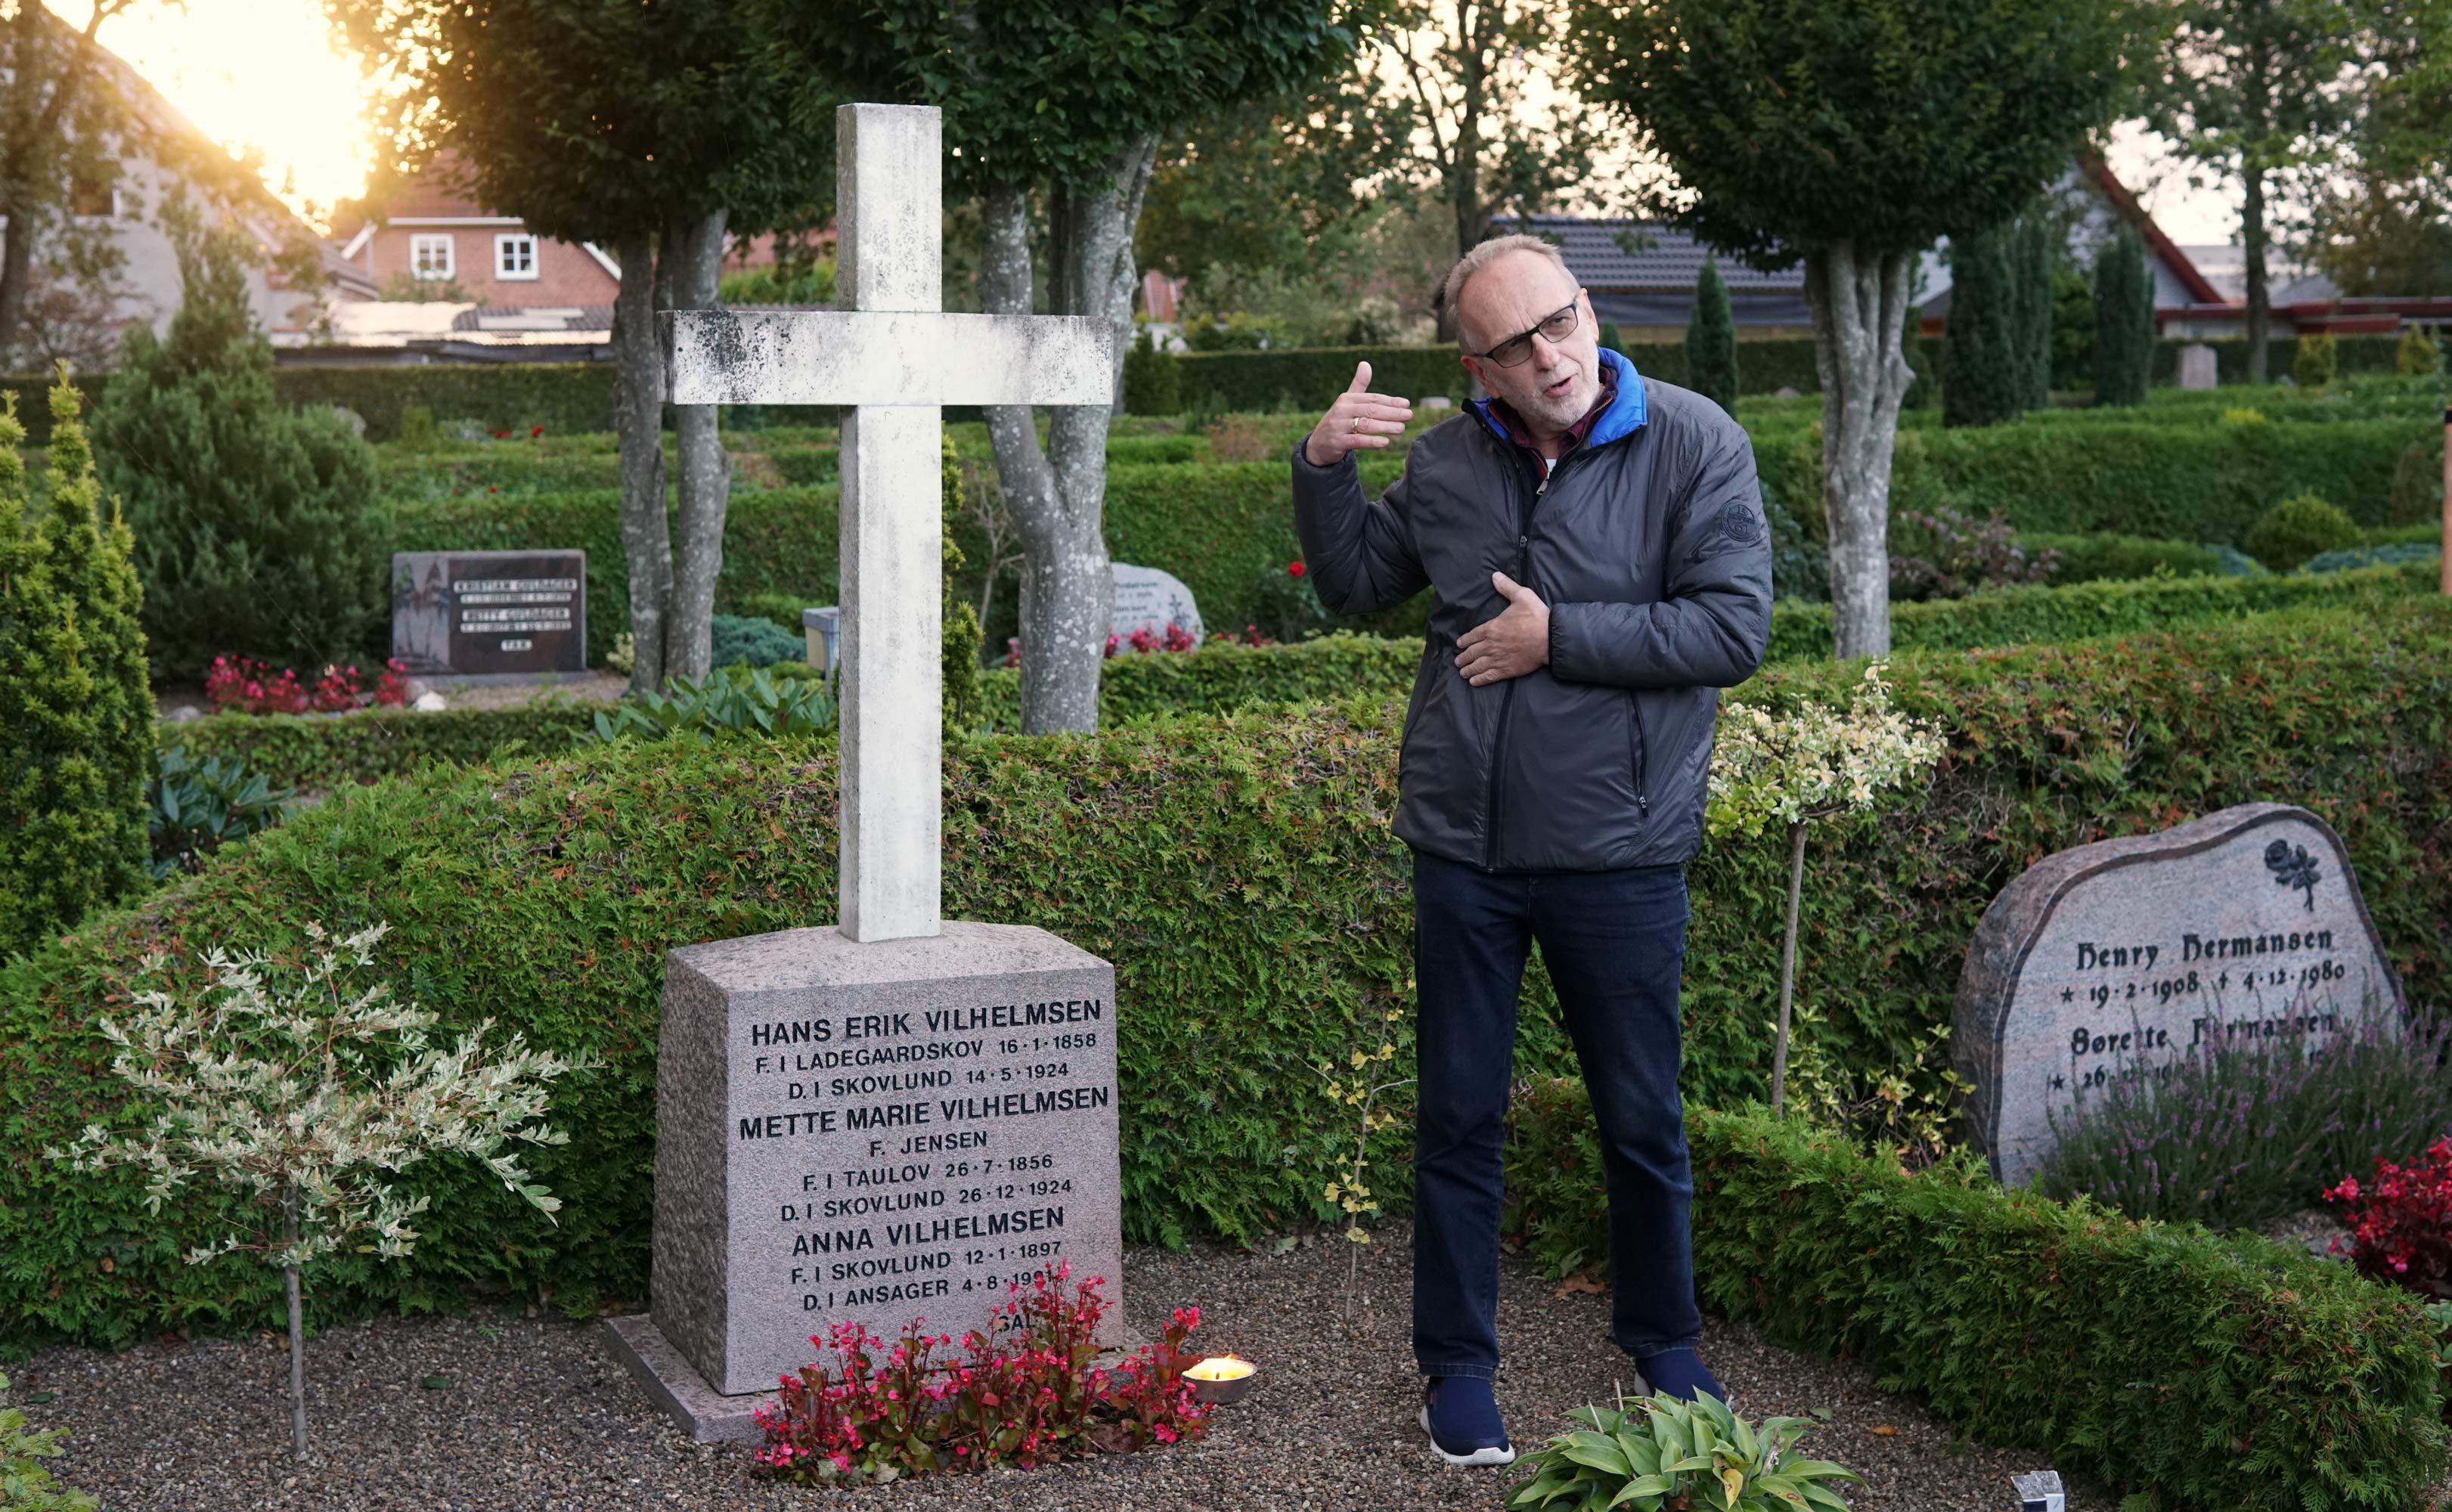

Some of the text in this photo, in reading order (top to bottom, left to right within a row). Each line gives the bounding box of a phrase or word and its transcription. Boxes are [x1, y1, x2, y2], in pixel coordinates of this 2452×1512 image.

[2076, 929, 2333, 971] Henry Hermansen
[752, 999, 1102, 1046] HANS ERIK VILHELMSEN
[2071, 1025, 2168, 1055] Sørete
[756, 1056, 770, 1074] F.
[780, 1056, 786, 1071] I
[797, 1040, 984, 1070] LADEGAARDSKOV
[789, 1083, 807, 1099] D.
[814, 1081, 820, 1098] I
[831, 1070, 952, 1096] SKOVLUND
[739, 1086, 1108, 1141] METTE MARIE VILHELMSEN
[870, 1131, 987, 1157] F. JENSEN
[803, 1175, 818, 1192] F.
[826, 1174, 832, 1189] I
[843, 1164, 931, 1187] TAULOV
[781, 1206, 800, 1222] D.
[807, 1204, 813, 1219] I
[823, 1190, 945, 1218] SKOVLUND
[792, 1207, 1064, 1256] ANNA VILHELMSEN
[792, 1269, 808, 1285] F.
[815, 1266, 820, 1283] I
[832, 1251, 951, 1281] SKOVLUND
[804, 1294, 822, 1311] D.
[829, 1293, 833, 1309] I
[845, 1280, 950, 1306] ANSAGER
